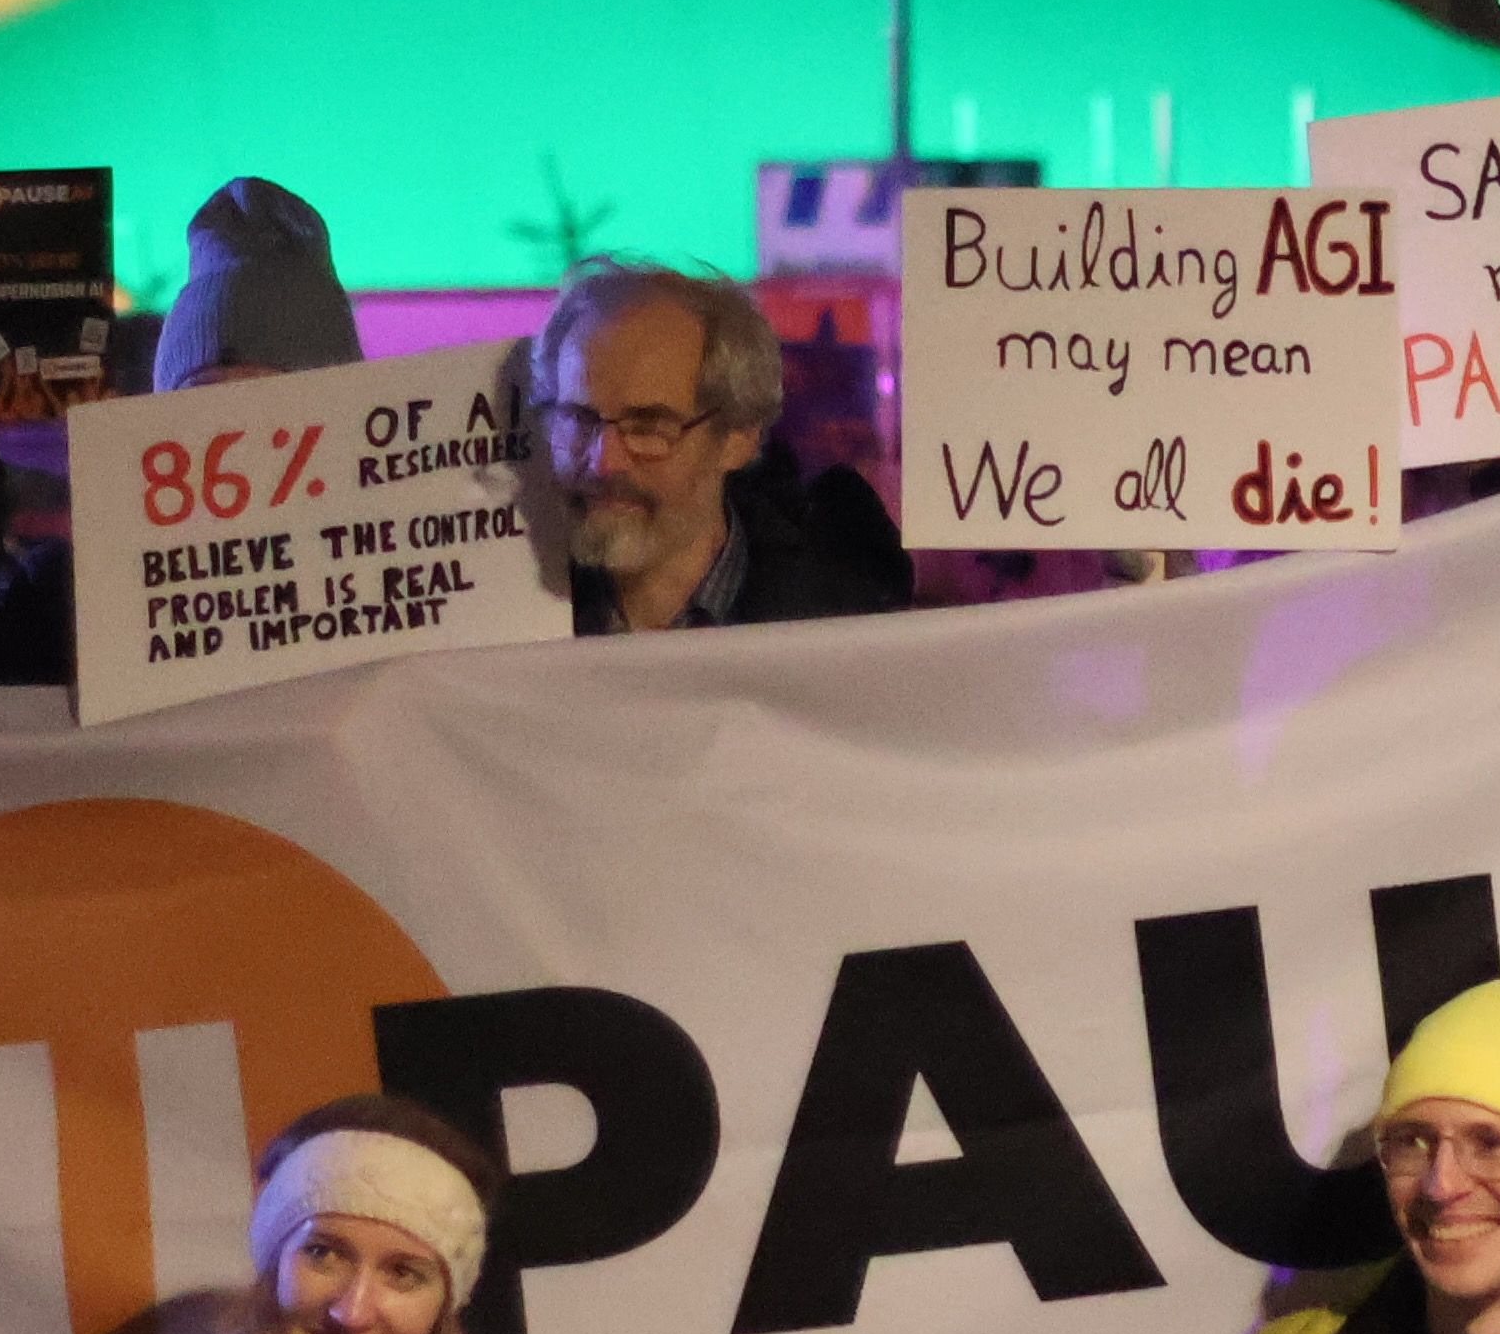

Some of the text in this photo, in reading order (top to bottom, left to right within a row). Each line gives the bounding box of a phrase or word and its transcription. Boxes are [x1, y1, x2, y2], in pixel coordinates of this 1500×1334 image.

[944, 197, 1396, 317] Building AGI
[996, 332, 1312, 397] may mean
[142, 426, 325, 526] 86%
[364, 400, 433, 448] OF
[359, 430, 531, 488] RESEARCHERS
[942, 437, 1380, 528] We all die!
[142, 504, 525, 588] BELIEVE THE CONTROL
[148, 560, 474, 628] PROBLEM IS REAL
[148, 598, 448, 663] AND IMPORTANT
